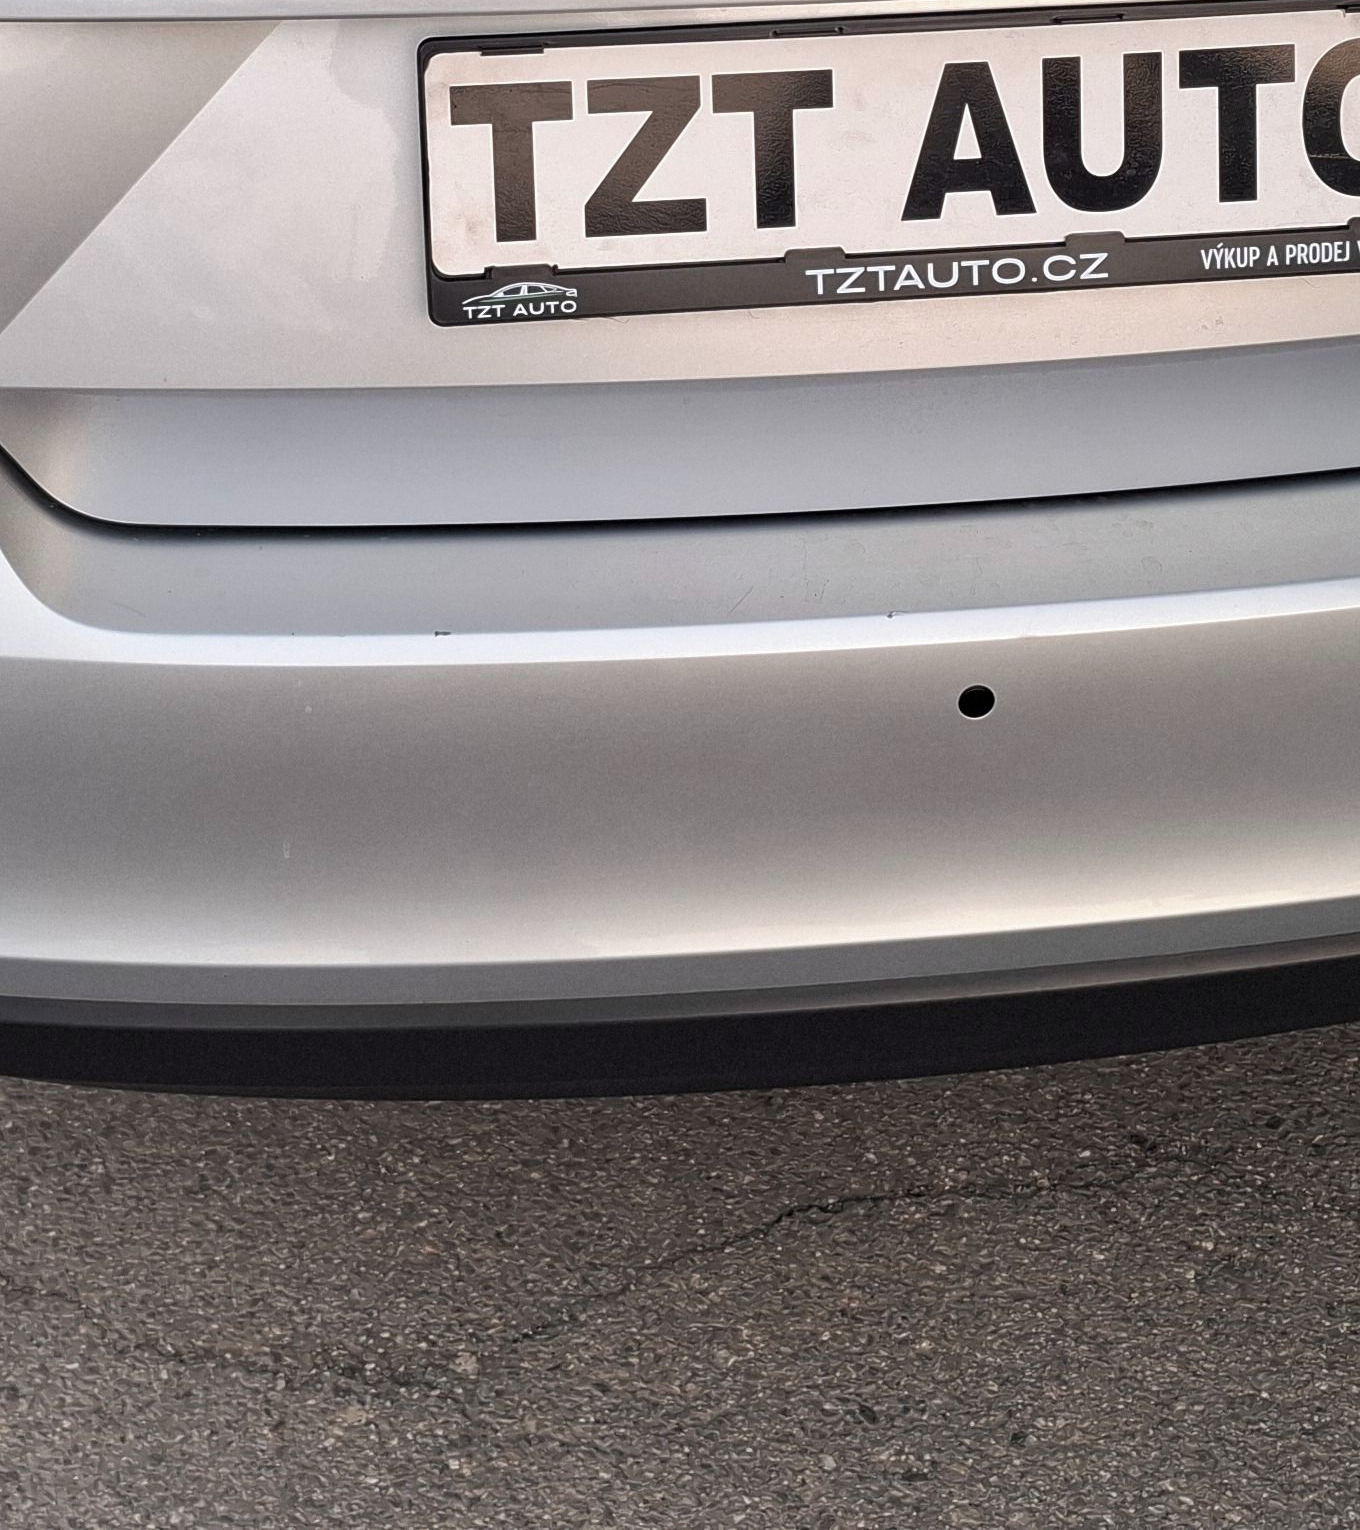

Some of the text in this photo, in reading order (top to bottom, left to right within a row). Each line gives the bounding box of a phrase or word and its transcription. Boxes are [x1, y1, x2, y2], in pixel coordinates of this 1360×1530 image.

[449, 69, 834, 242] TZT
[1201, 243, 1260, 269] VÝKUP
[1267, 246, 1279, 266] A
[1285, 241, 1351, 265] PRODEJ
[805, 252, 1109, 295] TZTAUTO.CZ
[463, 300, 577, 319] TZT AUTO
